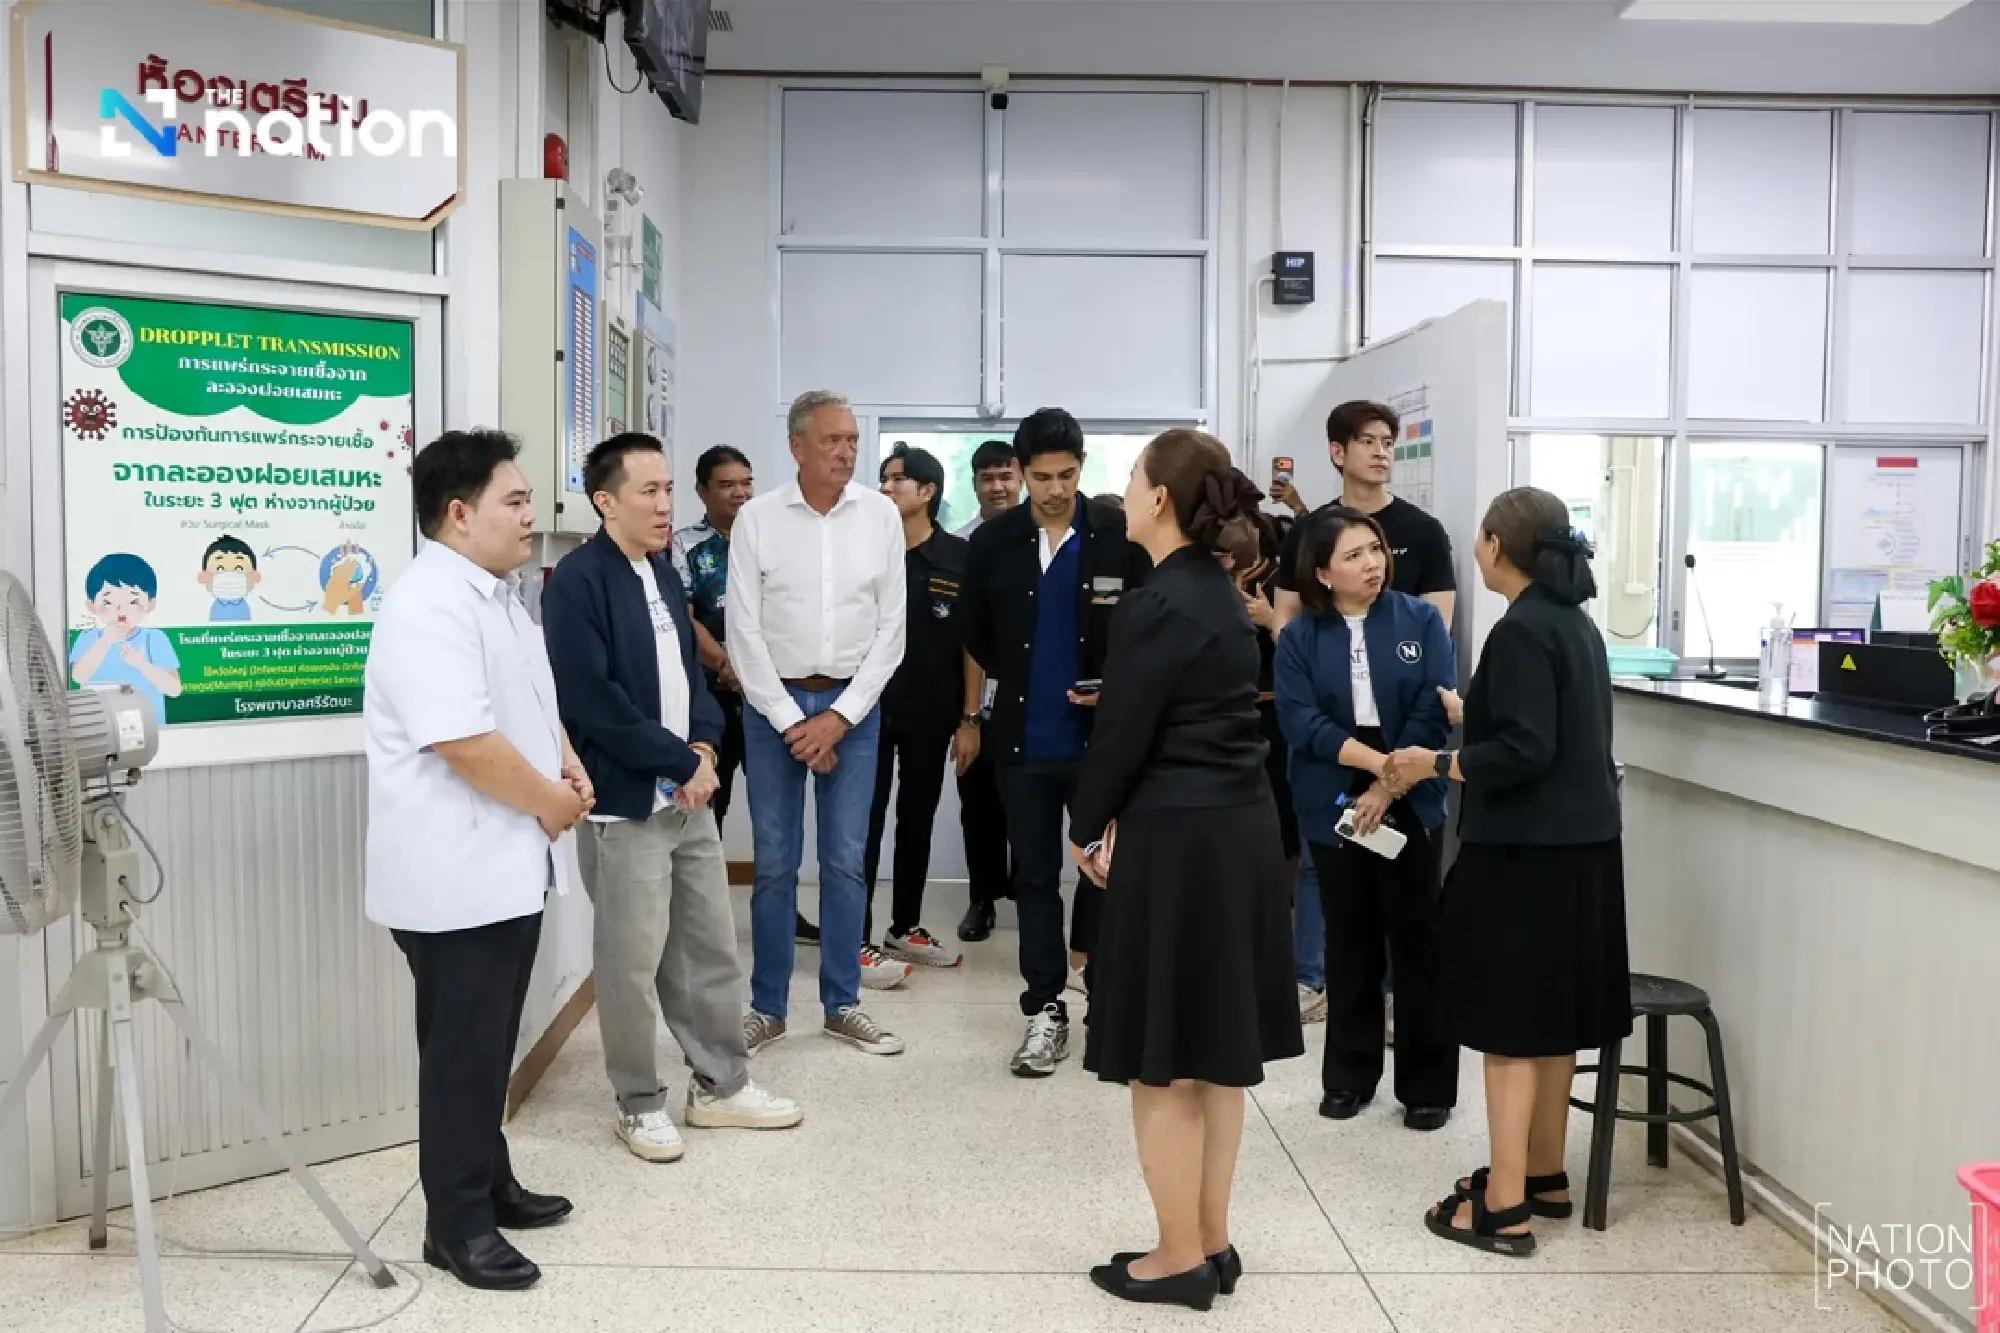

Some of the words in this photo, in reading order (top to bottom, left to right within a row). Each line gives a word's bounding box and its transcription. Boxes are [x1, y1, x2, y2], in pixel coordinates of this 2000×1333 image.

[178, 123, 325, 161] ANTERM
[140, 326, 253, 349] DROPPLET
[257, 336, 401, 361] TRANSMISSION
[178, 356, 367, 382] การแพร่กระจายเชื้อจาก
[122, 423, 375, 449] การป้องกันการแพร่กระจายเชื้อ
[112, 462, 382, 488] จากละอองฝอยเสมหะ
[143, 491, 205, 508] ในระยะ
[211, 492, 223, 508] 3
[230, 494, 258, 514] ฟุต
[264, 493, 375, 516] ห่างจากผู้ป่วย
[204, 519, 241, 530] Surgical
[245, 519, 270, 529] Mask
